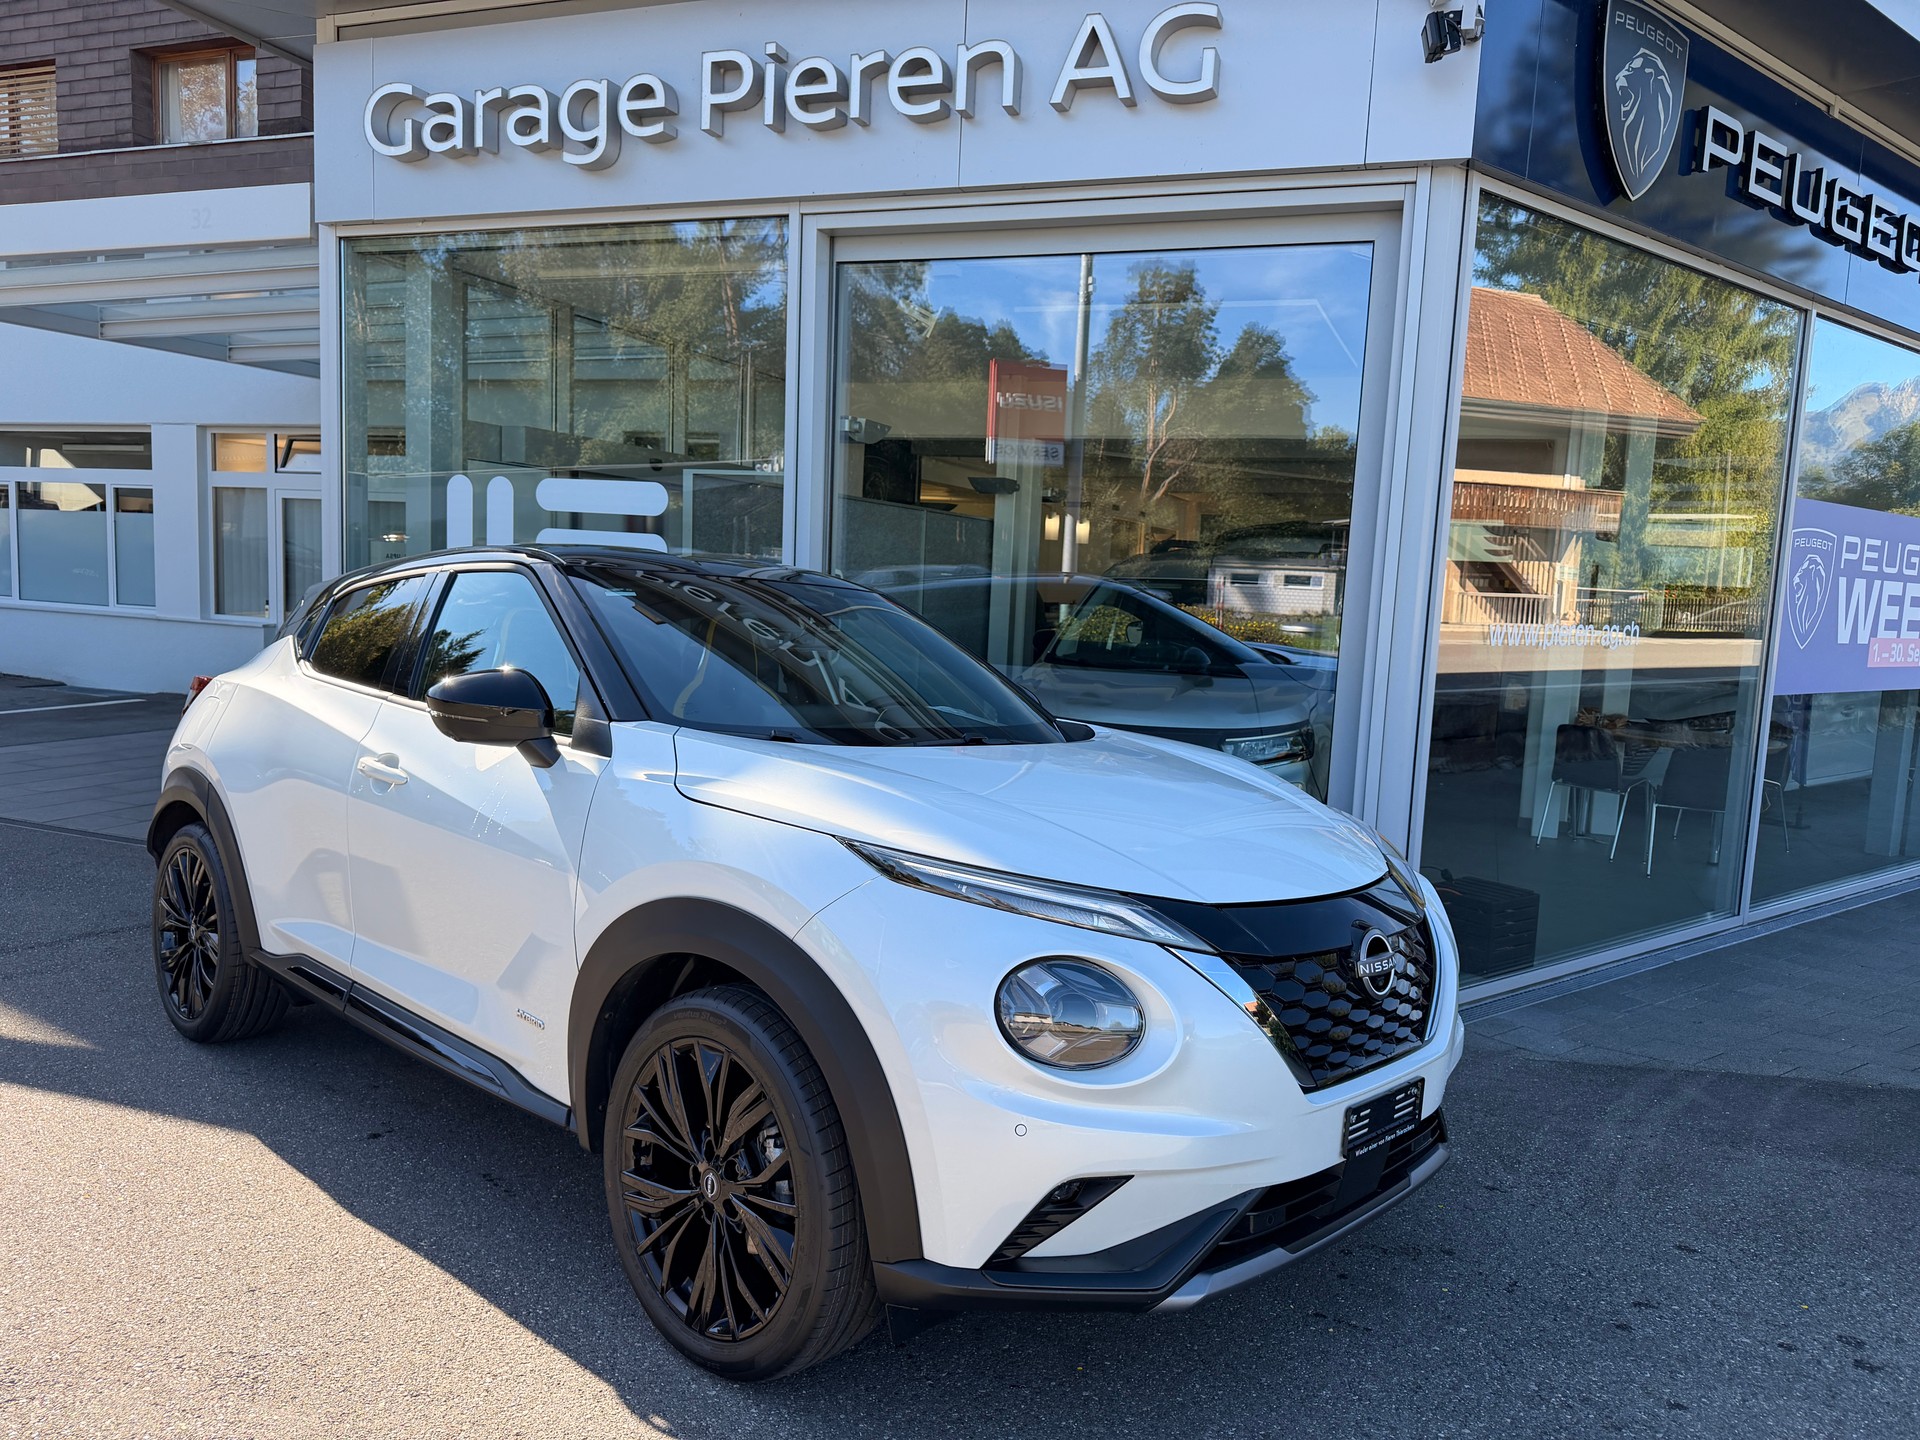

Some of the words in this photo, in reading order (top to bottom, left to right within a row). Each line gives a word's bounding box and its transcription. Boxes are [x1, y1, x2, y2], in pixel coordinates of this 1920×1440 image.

[1614, 11, 1683, 59] PEUGEOT
[363, 74, 677, 170] Garage
[701, 40, 1020, 137] Pieren
[1049, 2, 1223, 112] AG
[1794, 538, 1833, 552] PEUGEOT
[1840, 535, 1920, 576] PEUG
[1837, 576, 1920, 645] WEE
[1489, 620, 1640, 650] www.pieren-ag.ch
[1907, 643, 1920, 666] Se
[1360, 955, 1397, 975] NISSAN
